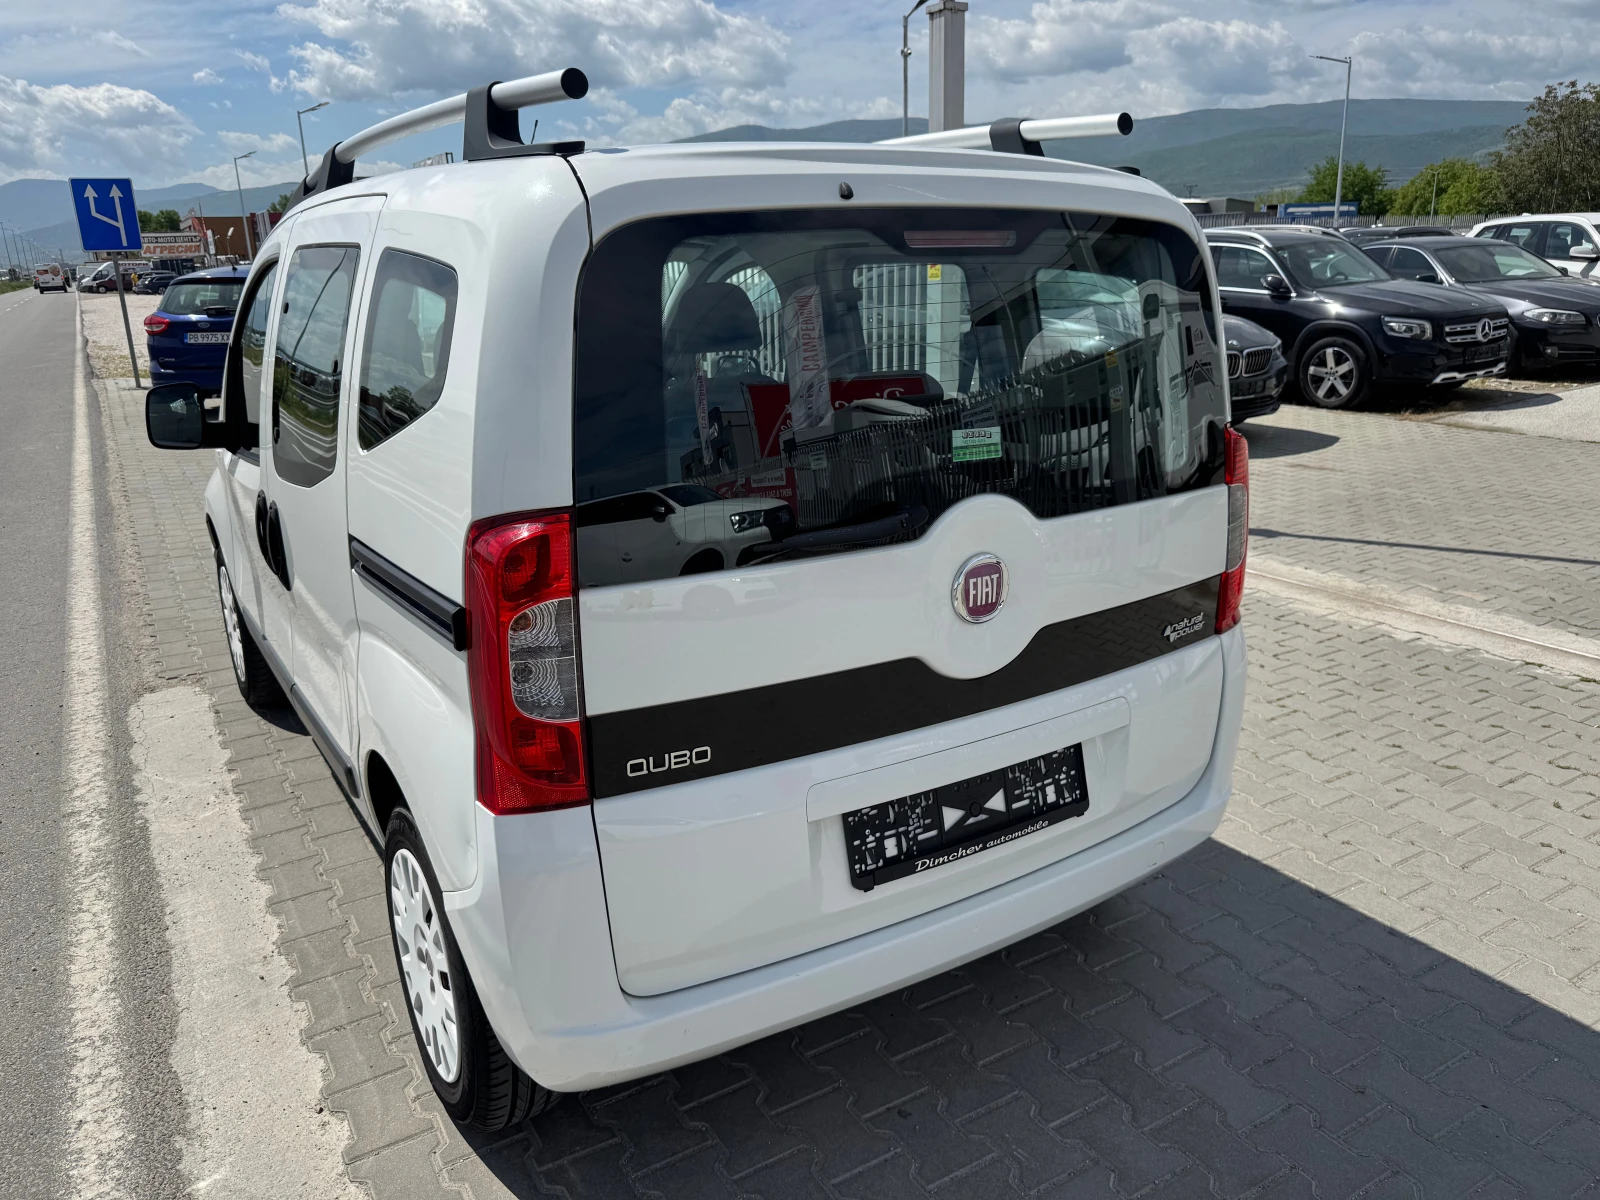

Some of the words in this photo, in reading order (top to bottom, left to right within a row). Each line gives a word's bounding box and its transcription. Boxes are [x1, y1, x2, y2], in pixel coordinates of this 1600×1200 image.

[143, 244, 201, 254] АГРЕСИЯ
[188, 333, 199, 342] PB
[200, 333, 219, 342] 9975
[969, 574, 999, 607] FIAT
[1171, 611, 1204, 631] natural
[1174, 620, 1205, 641] power
[626, 746, 711, 777] QUBO
[914, 844, 983, 872] Dimchev
[986, 820, 1049, 848] automobile
